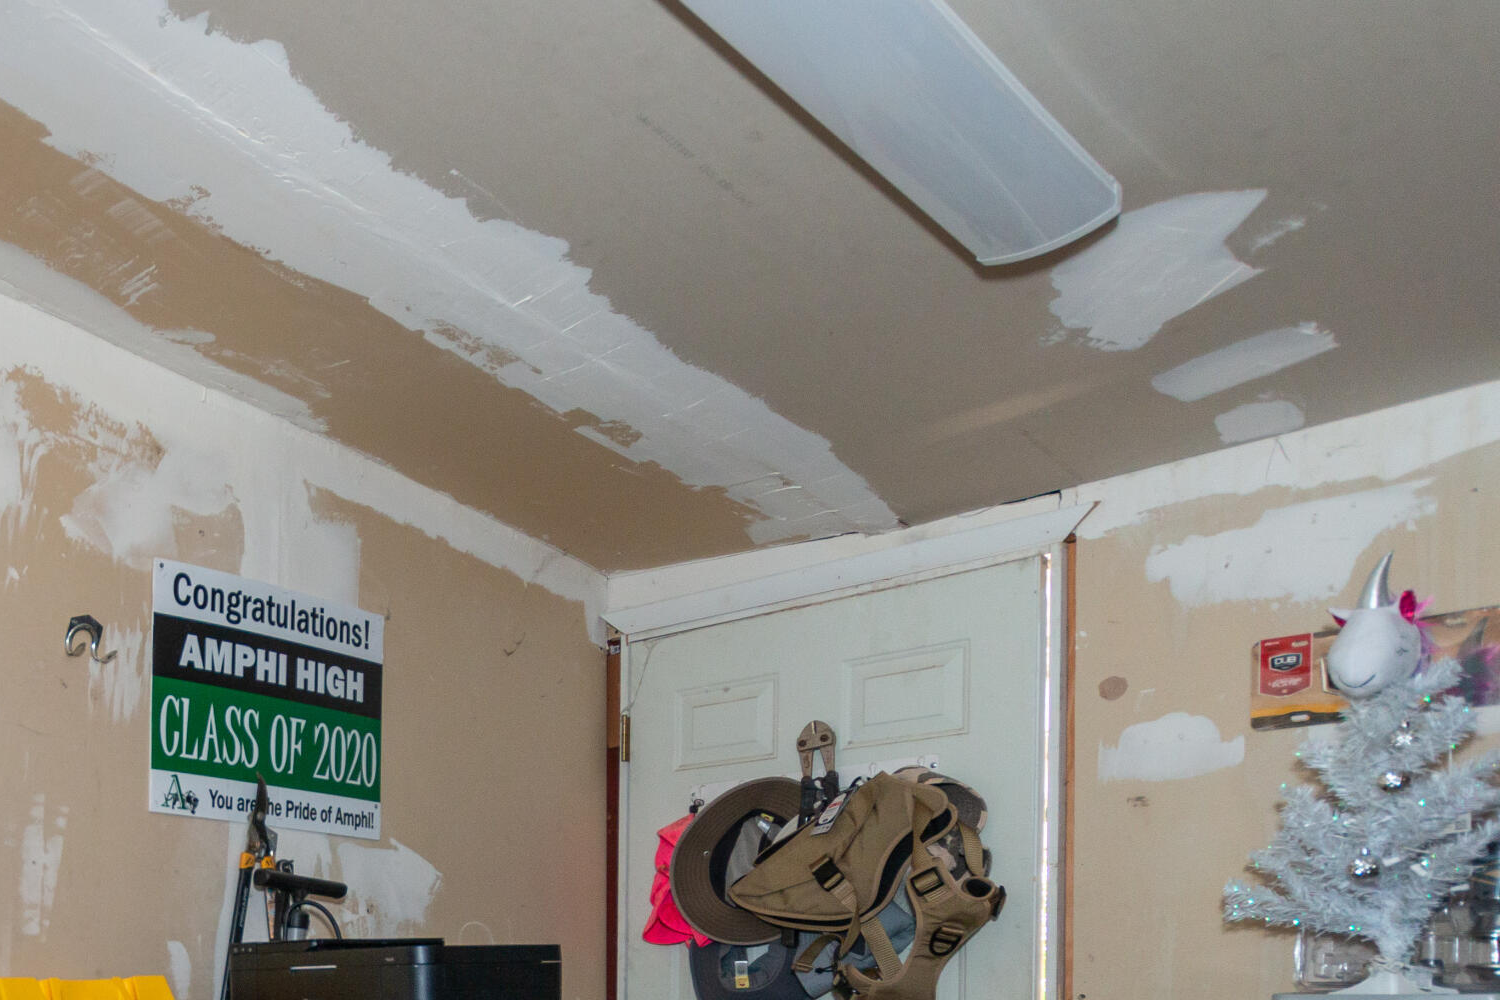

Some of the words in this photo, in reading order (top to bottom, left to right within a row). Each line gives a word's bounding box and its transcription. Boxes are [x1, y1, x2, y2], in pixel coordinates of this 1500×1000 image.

[172, 572, 370, 650] Congratulations!
[179, 634, 288, 686] AMPHI
[296, 657, 365, 703] HIGH
[159, 694, 260, 769] CLASS
[269, 714, 307, 775] OF
[312, 722, 378, 788] 2020
[208, 788, 233, 810] You
[237, 798, 256, 812] are
[266, 798, 282, 816] he
[286, 800, 317, 821] Pride
[321, 805, 333, 823] of
[335, 807, 375, 831] Amphi!
